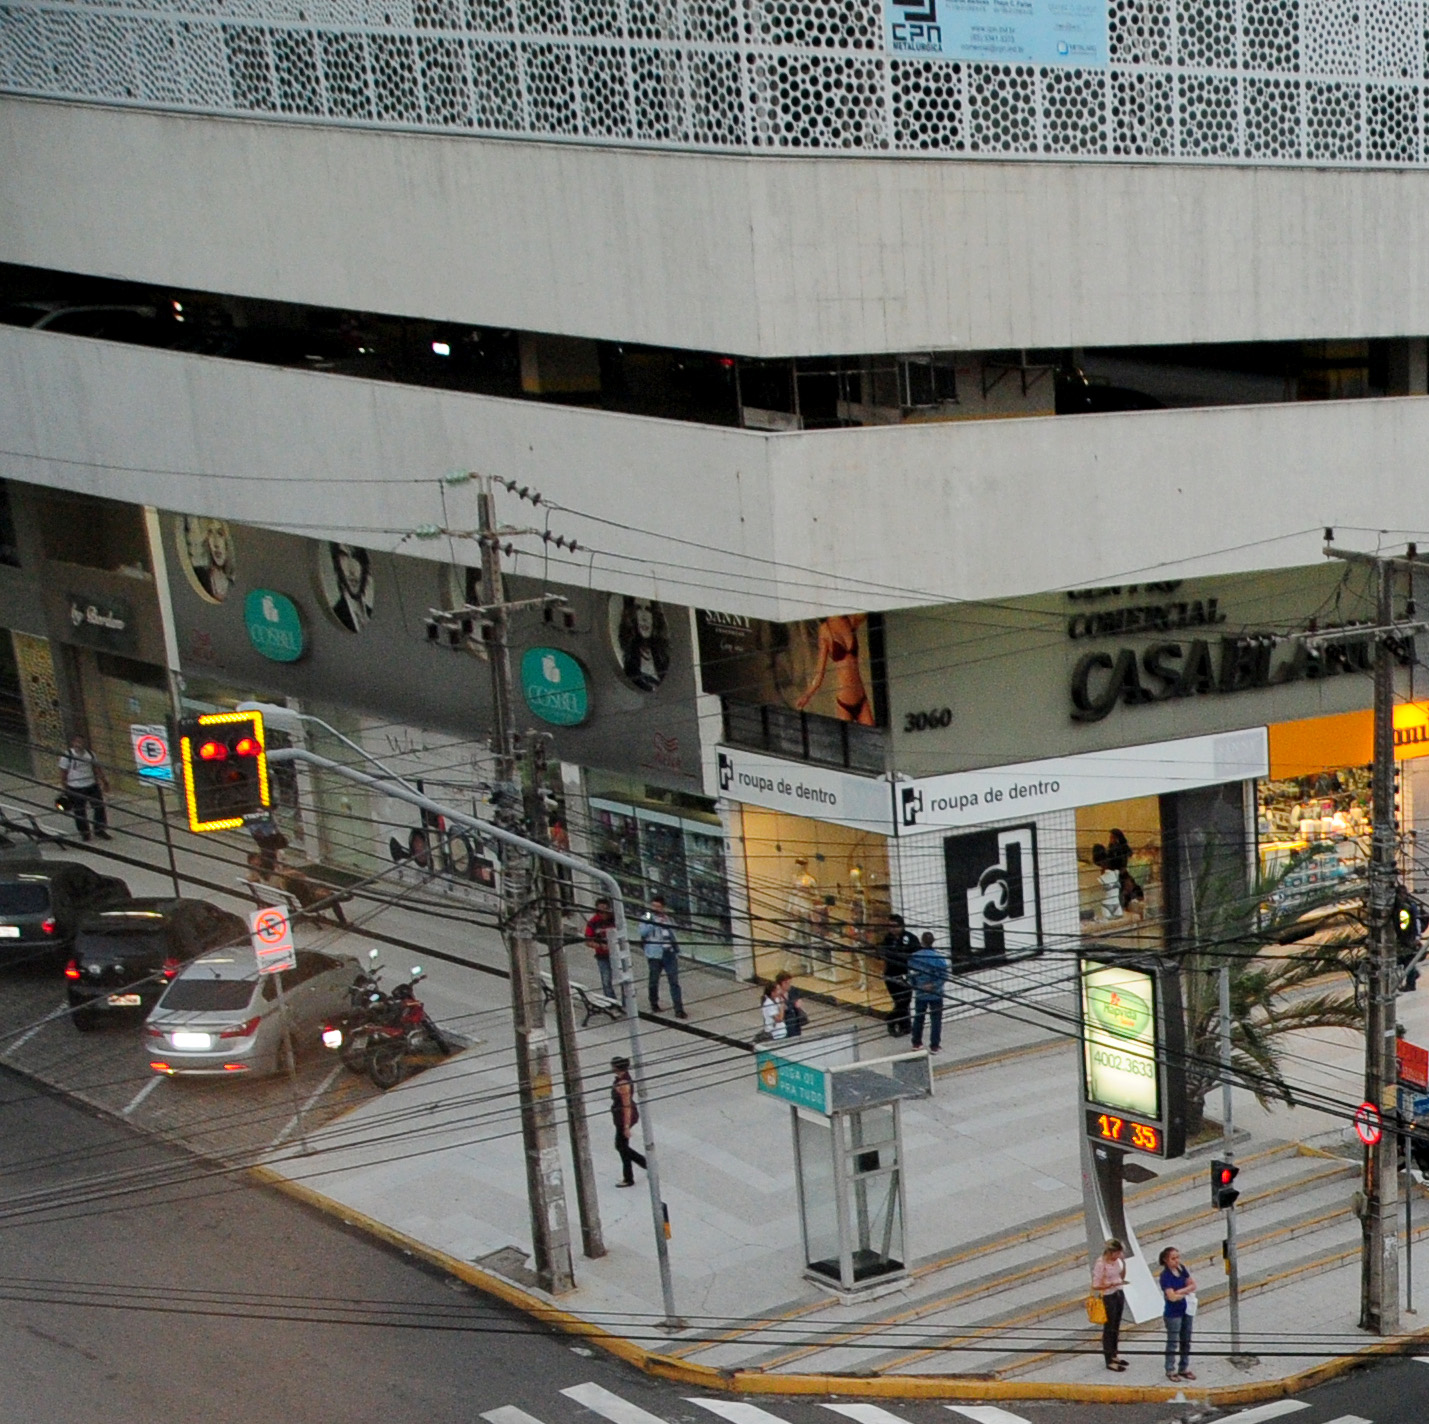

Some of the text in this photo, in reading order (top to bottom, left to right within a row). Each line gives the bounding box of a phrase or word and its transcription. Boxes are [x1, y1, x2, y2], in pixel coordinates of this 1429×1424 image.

[1068, 598, 1227, 639] COMERCIAL
[904, 707, 952, 733] 3060
[738, 772, 774, 793] roupa
[777, 778, 793, 796] de
[796, 783, 837, 806] dentro
[931, 793, 979, 814] roupa
[984, 786, 1003, 804] de
[1010, 779, 1060, 802] dentro
[1094, 1050, 1154, 1079] 4002.3633
[1098, 1114, 1158, 1150] 17 35
